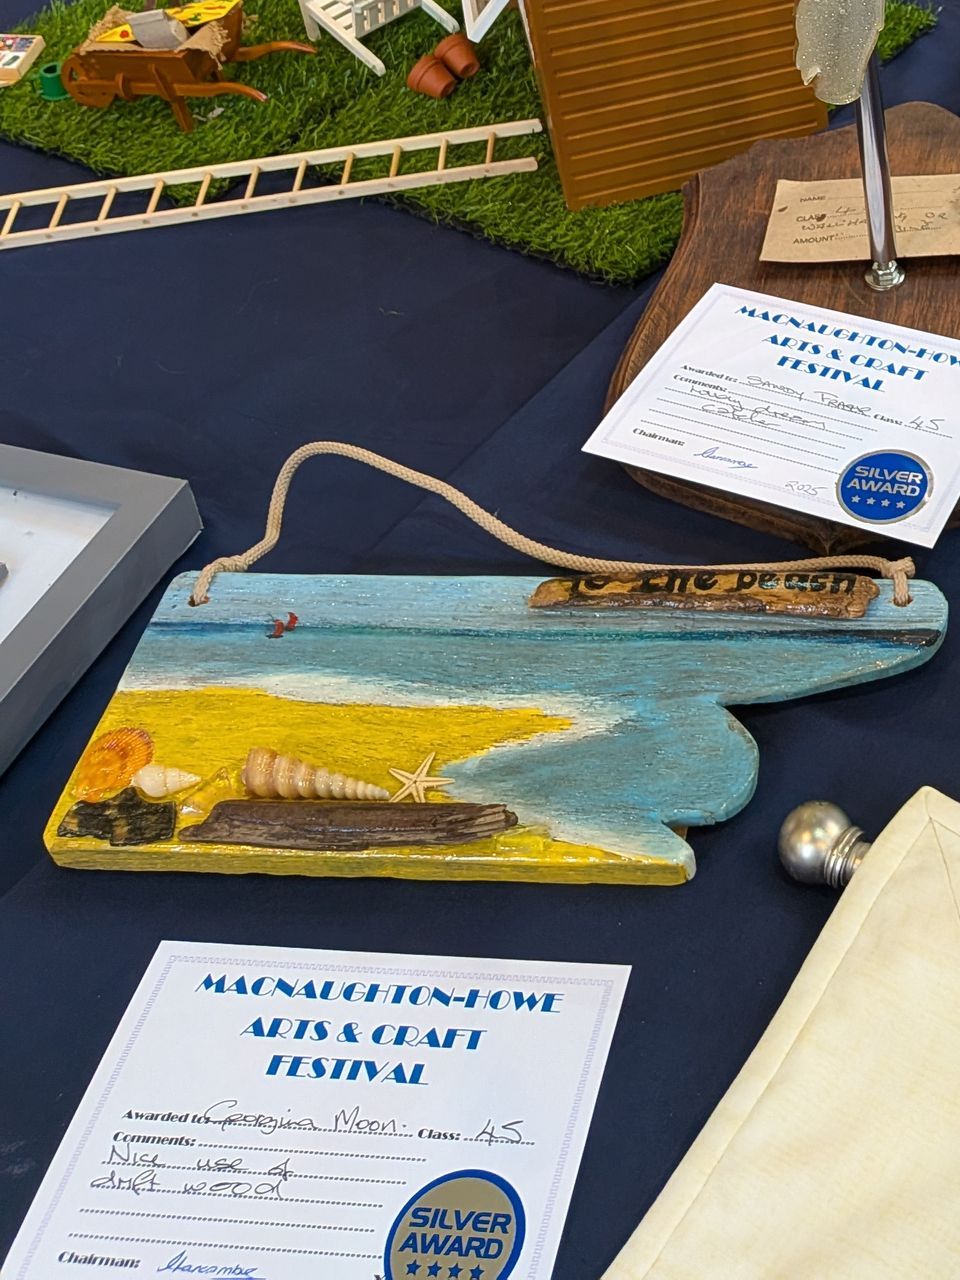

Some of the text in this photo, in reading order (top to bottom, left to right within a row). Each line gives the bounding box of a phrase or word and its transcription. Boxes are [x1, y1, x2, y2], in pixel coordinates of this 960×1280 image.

[793, 234, 835, 245] AMOUNT
[761, 334, 929, 381] ARTS & CRAFT
[673, 374, 728, 393] Comments:
[776, 356, 885, 393] FESTIVAL
[681, 365, 729, 379] Awarded
[874, 413, 902, 426] Class:
[632, 427, 686, 447] Chairman:
[847, 478, 920, 497] AWARD
[855, 465, 923, 484] SILVER
[195, 973, 564, 1014] MACNAUGHTON-HOWE
[240, 1017, 488, 1051] ARTS & CRAFT
[265, 1054, 429, 1086] FESTIVAL
[122, 1109, 190, 1124] Awarded
[418, 1128, 461, 1141] Class:
[113, 1131, 196, 1147] Comments:
[409, 1207, 512, 1234] SILVER
[398, 1232, 504, 1259] AWARD
[58, 1250, 141, 1269] Chairman:
